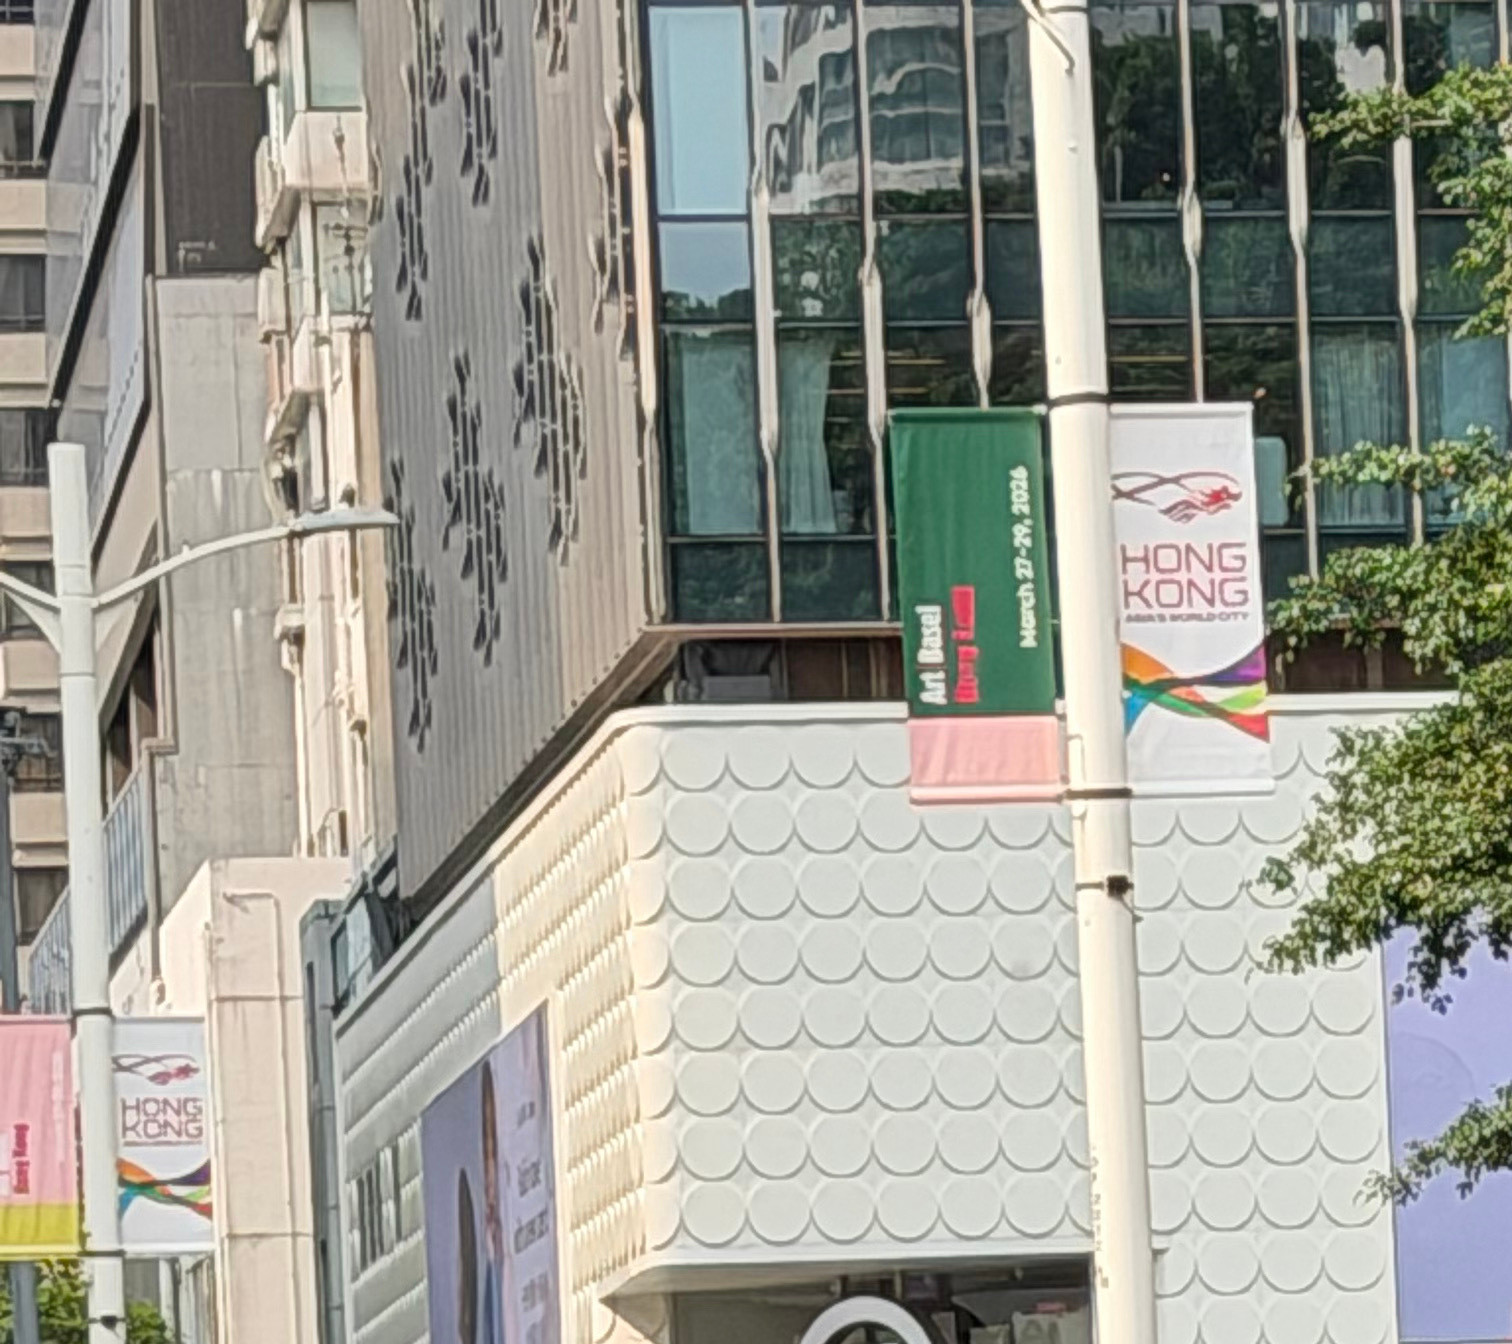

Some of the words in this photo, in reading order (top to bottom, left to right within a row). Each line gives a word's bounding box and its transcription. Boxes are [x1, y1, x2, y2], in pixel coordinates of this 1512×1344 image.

[1119, 542, 1248, 576] HONG
[1123, 576, 1250, 610] KONG
[1018, 582, 1038, 648] March
[914, 605, 944, 664] Basel
[919, 670, 948, 705] Art
[120, 1097, 204, 1118] HONG
[121, 1118, 204, 1139] KONG
